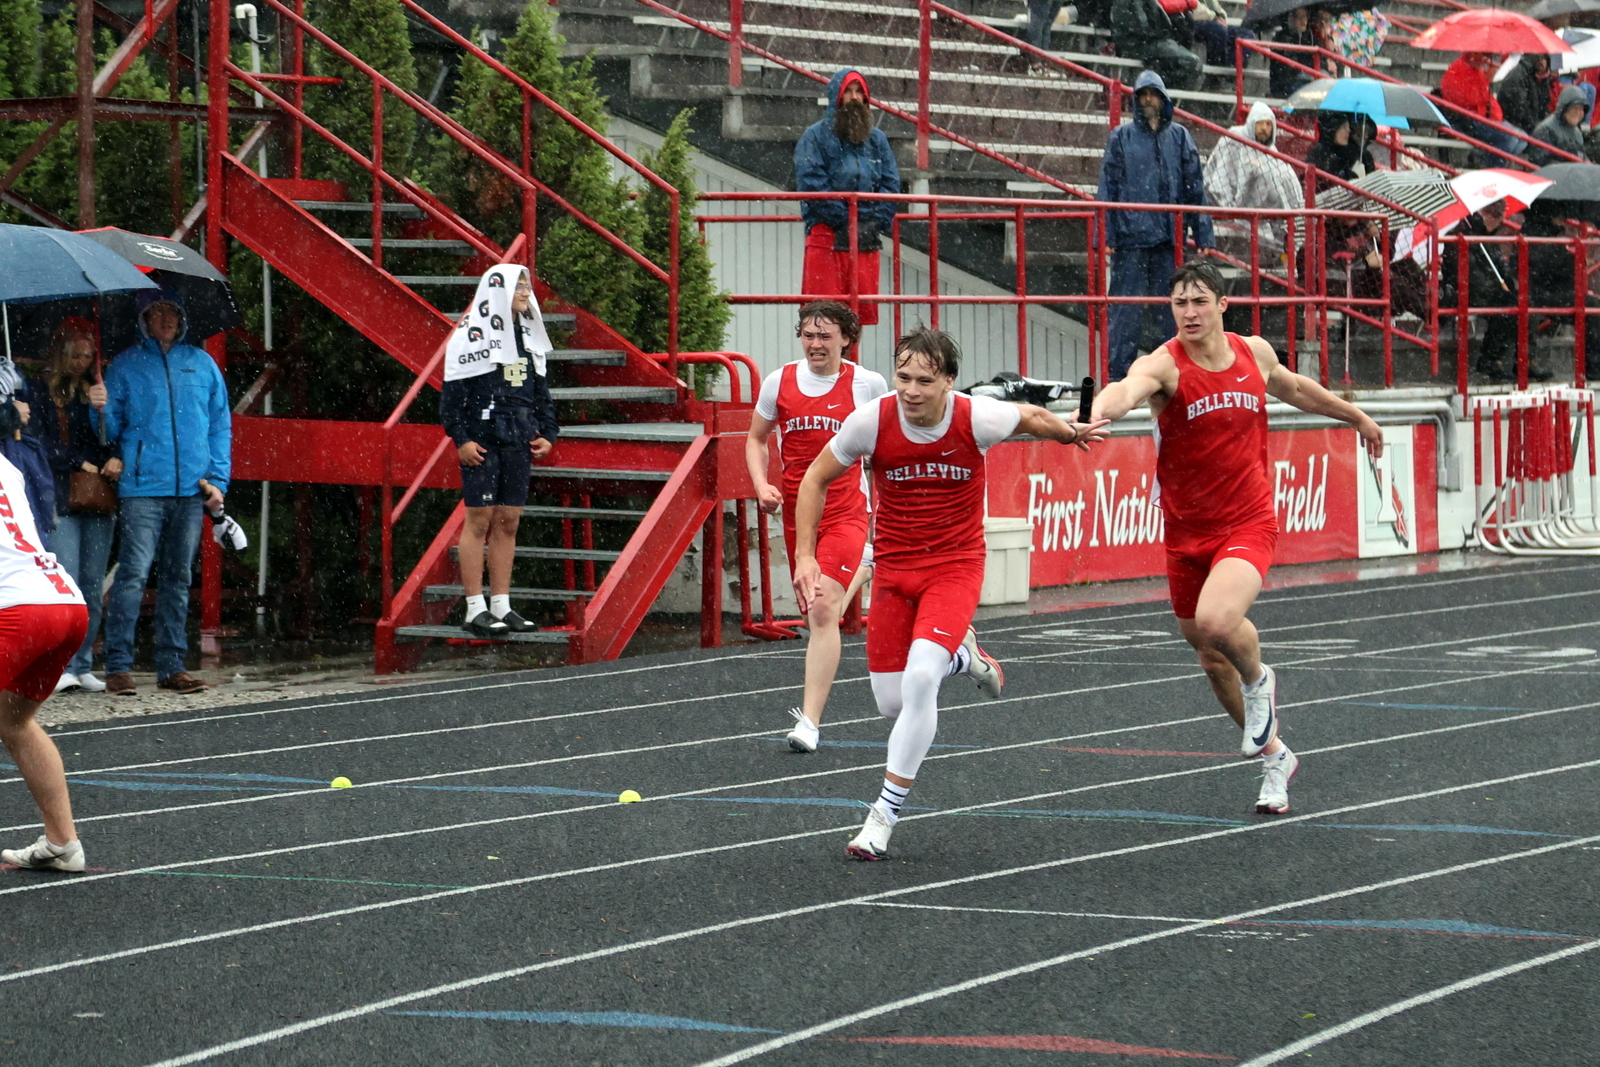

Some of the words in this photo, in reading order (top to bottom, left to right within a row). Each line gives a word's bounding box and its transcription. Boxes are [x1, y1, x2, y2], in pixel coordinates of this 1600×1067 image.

[1187, 391, 1259, 420] BELLEVUE
[785, 414, 844, 434] BELLEVU
[886, 462, 971, 481] BELLEVUE
[1274, 453, 1328, 533] Field
[1027, 473, 1086, 552] First
